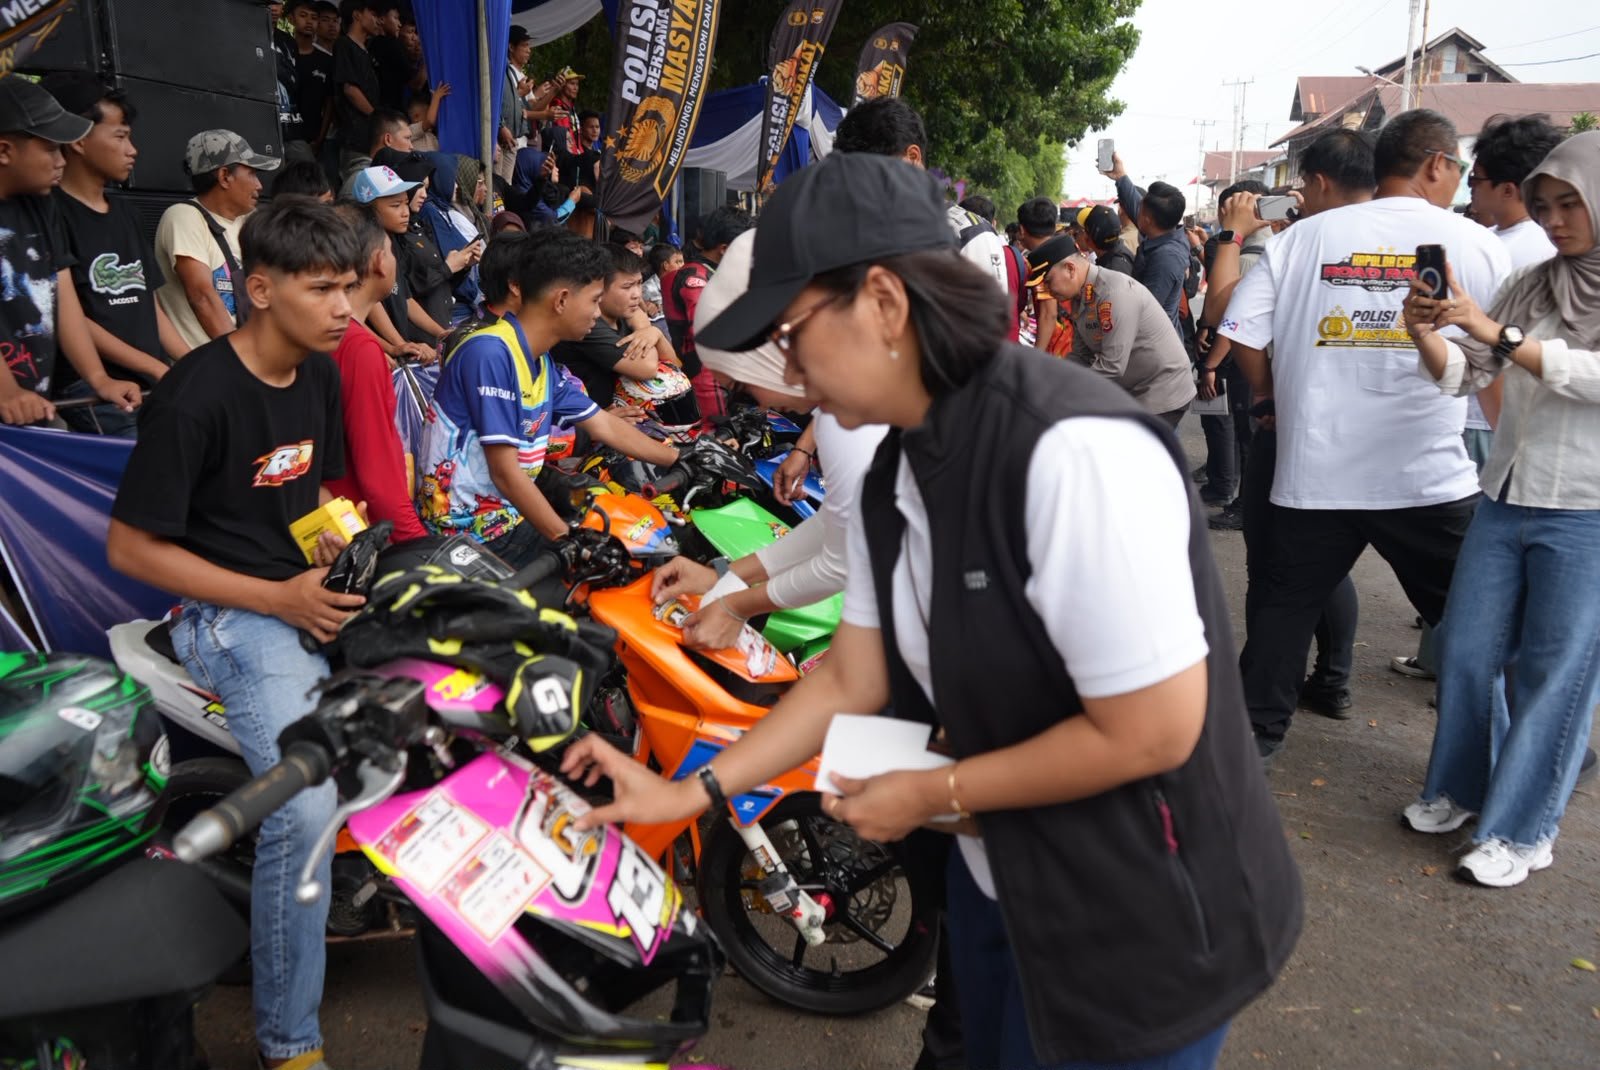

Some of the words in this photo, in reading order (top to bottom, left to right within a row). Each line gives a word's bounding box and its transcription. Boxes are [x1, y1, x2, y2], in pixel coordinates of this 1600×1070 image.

[1, 0, 48, 27] ME
[621, 0, 659, 104] POLISI
[646, 8, 670, 90] BERSAMA
[660, 0, 697, 95] MASYA
[668, 100, 696, 167] MELINDUNGI,
[688, 31, 709, 97] MENGAYOMI
[703, 4, 713, 29] DAN
[1323, 266, 1382, 278] ROAD
[1351, 310, 1398, 322] POLISI
